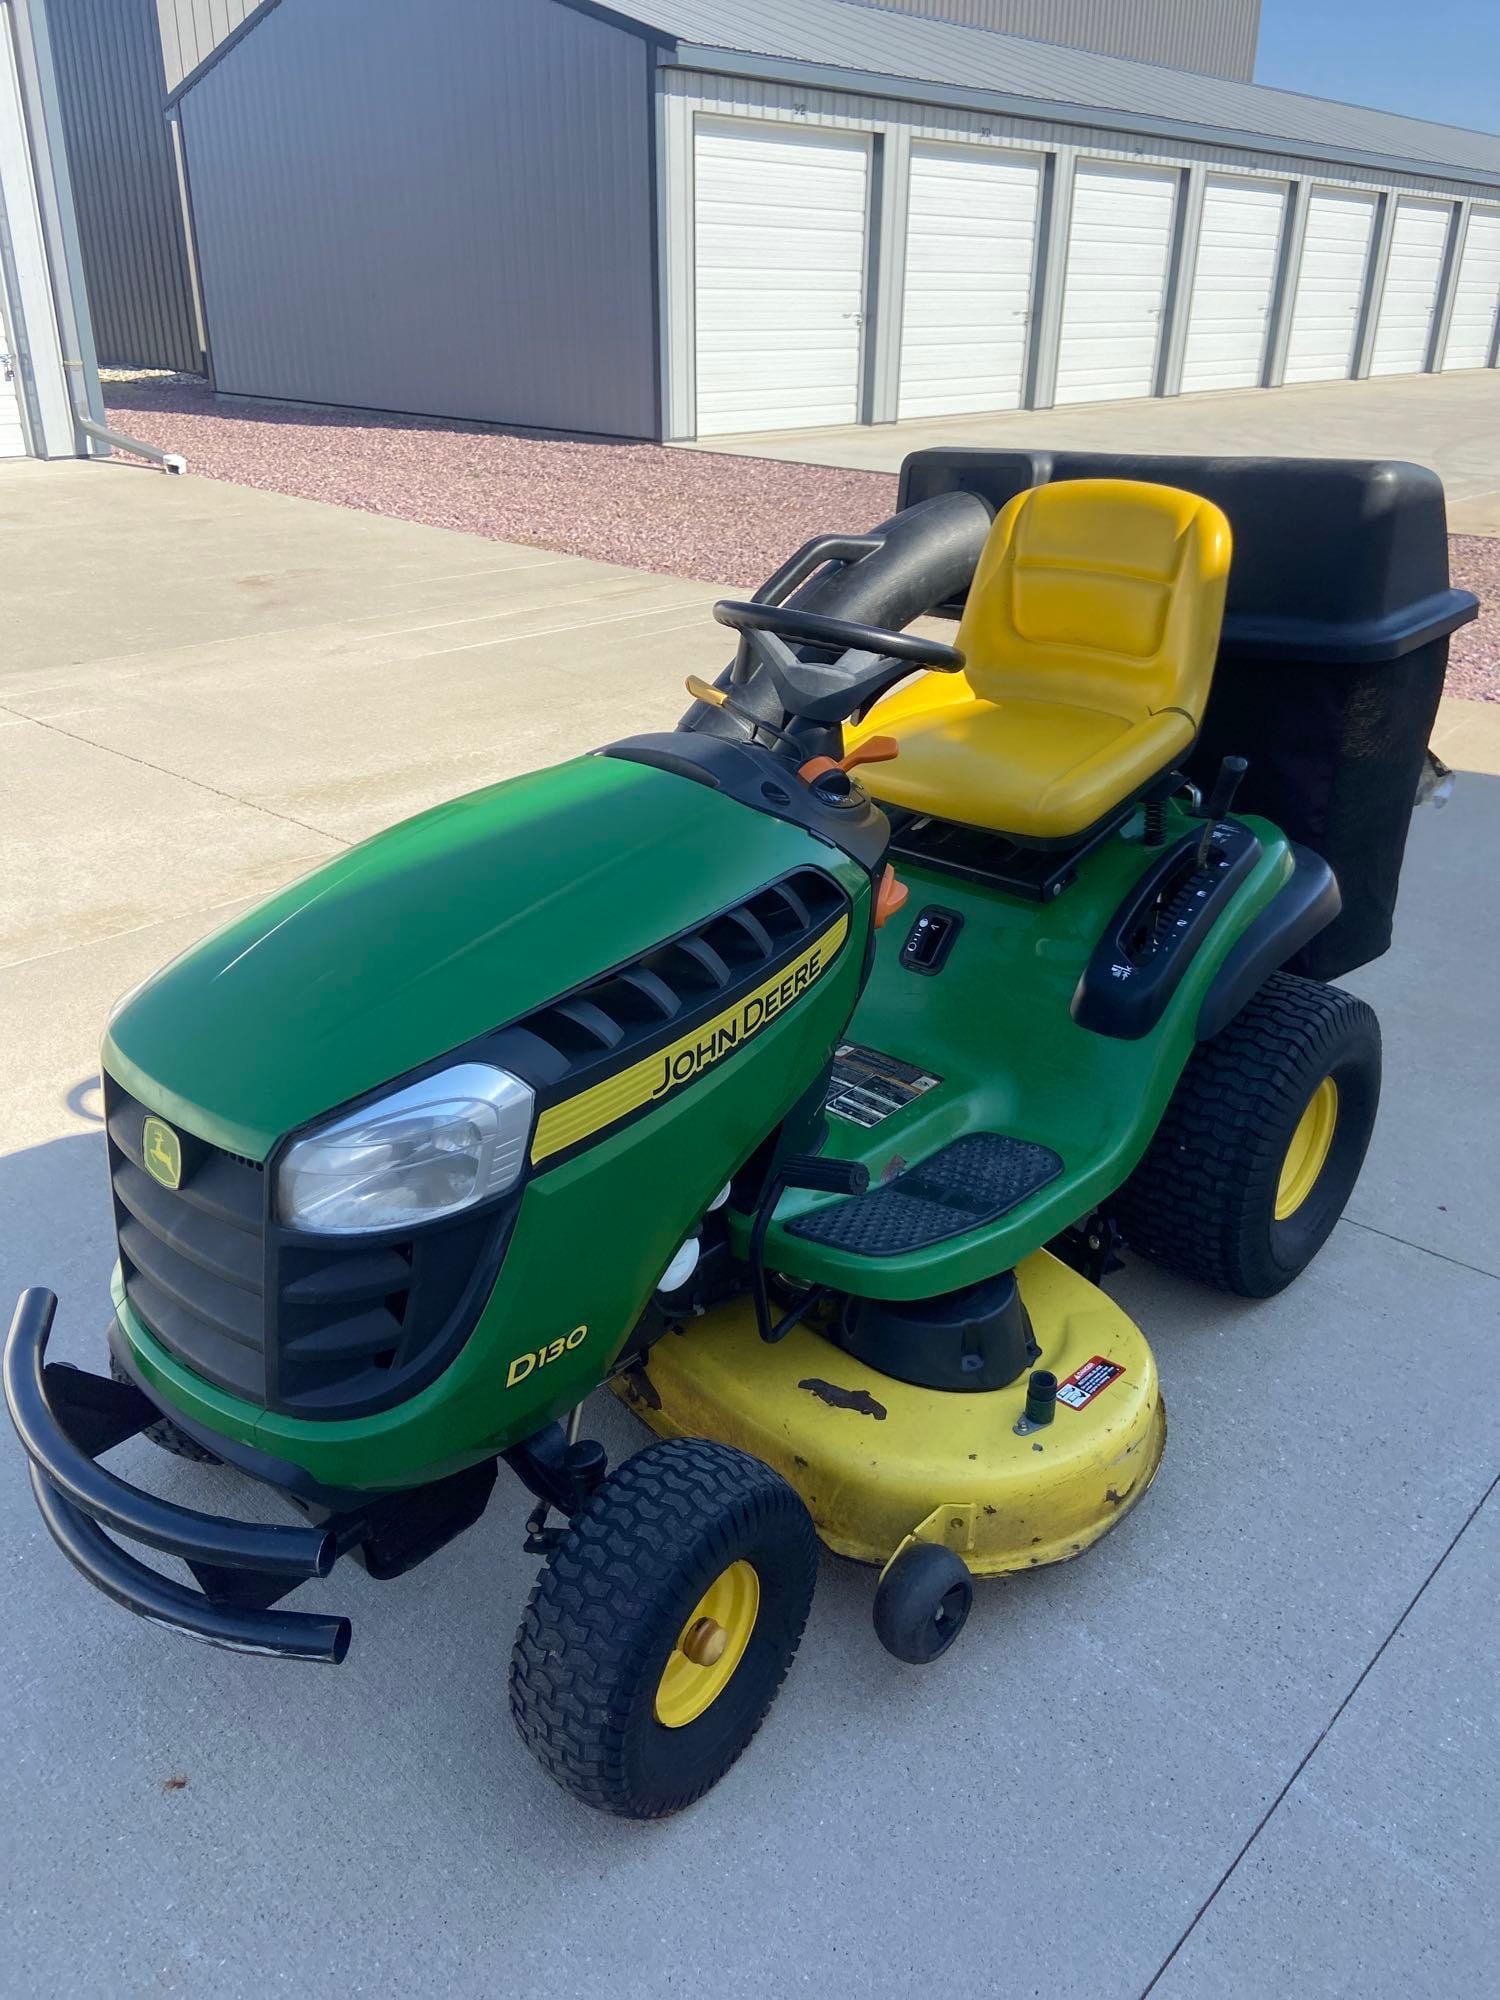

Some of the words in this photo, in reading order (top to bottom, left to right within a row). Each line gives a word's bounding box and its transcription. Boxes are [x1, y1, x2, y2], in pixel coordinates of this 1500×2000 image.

[652, 1018, 737, 1096] JOHN
[743, 948, 822, 1035] DEERE
[506, 1325, 588, 1388] D130
